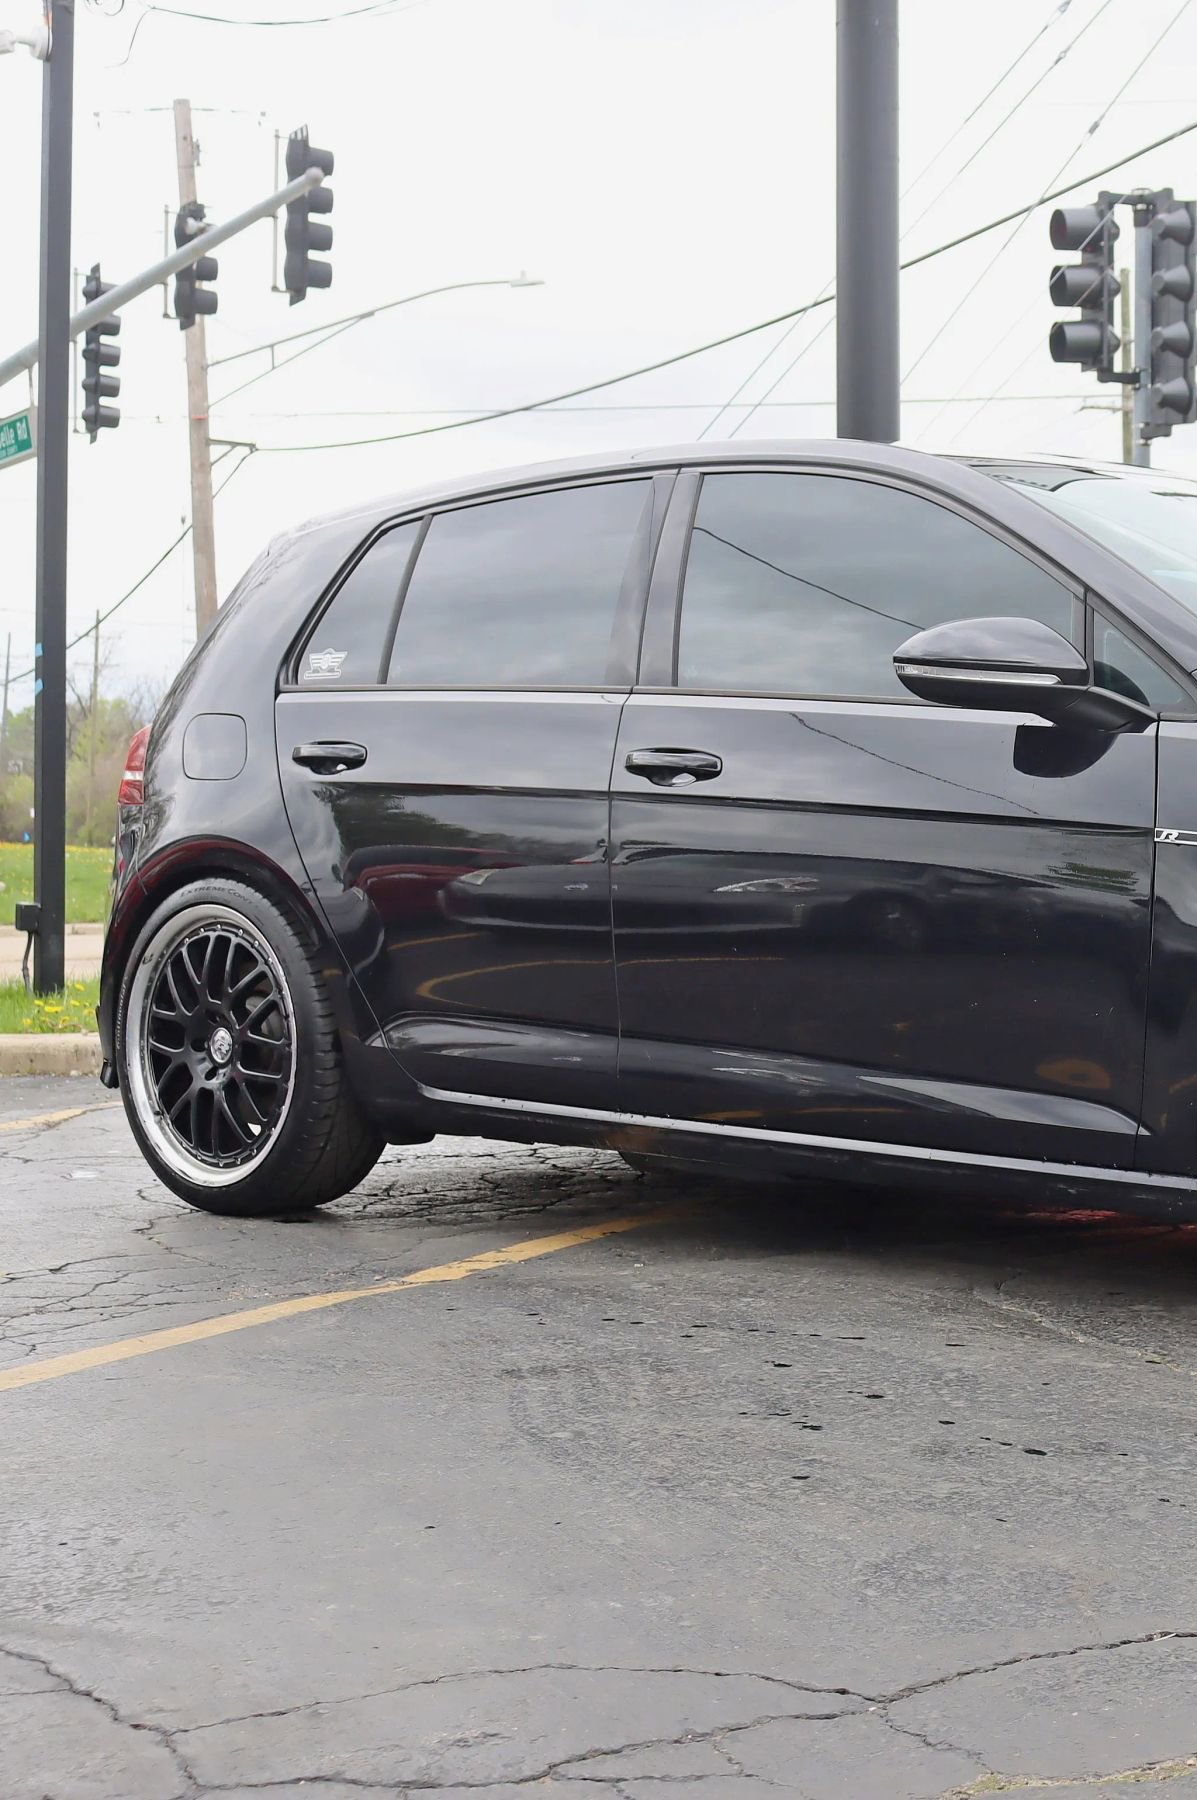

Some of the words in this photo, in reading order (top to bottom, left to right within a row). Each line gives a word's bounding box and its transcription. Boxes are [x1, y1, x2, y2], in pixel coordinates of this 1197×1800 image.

[0, 424, 15, 449] elle
[16, 417, 28, 440] Rd
[1159, 830, 1179, 841] R
